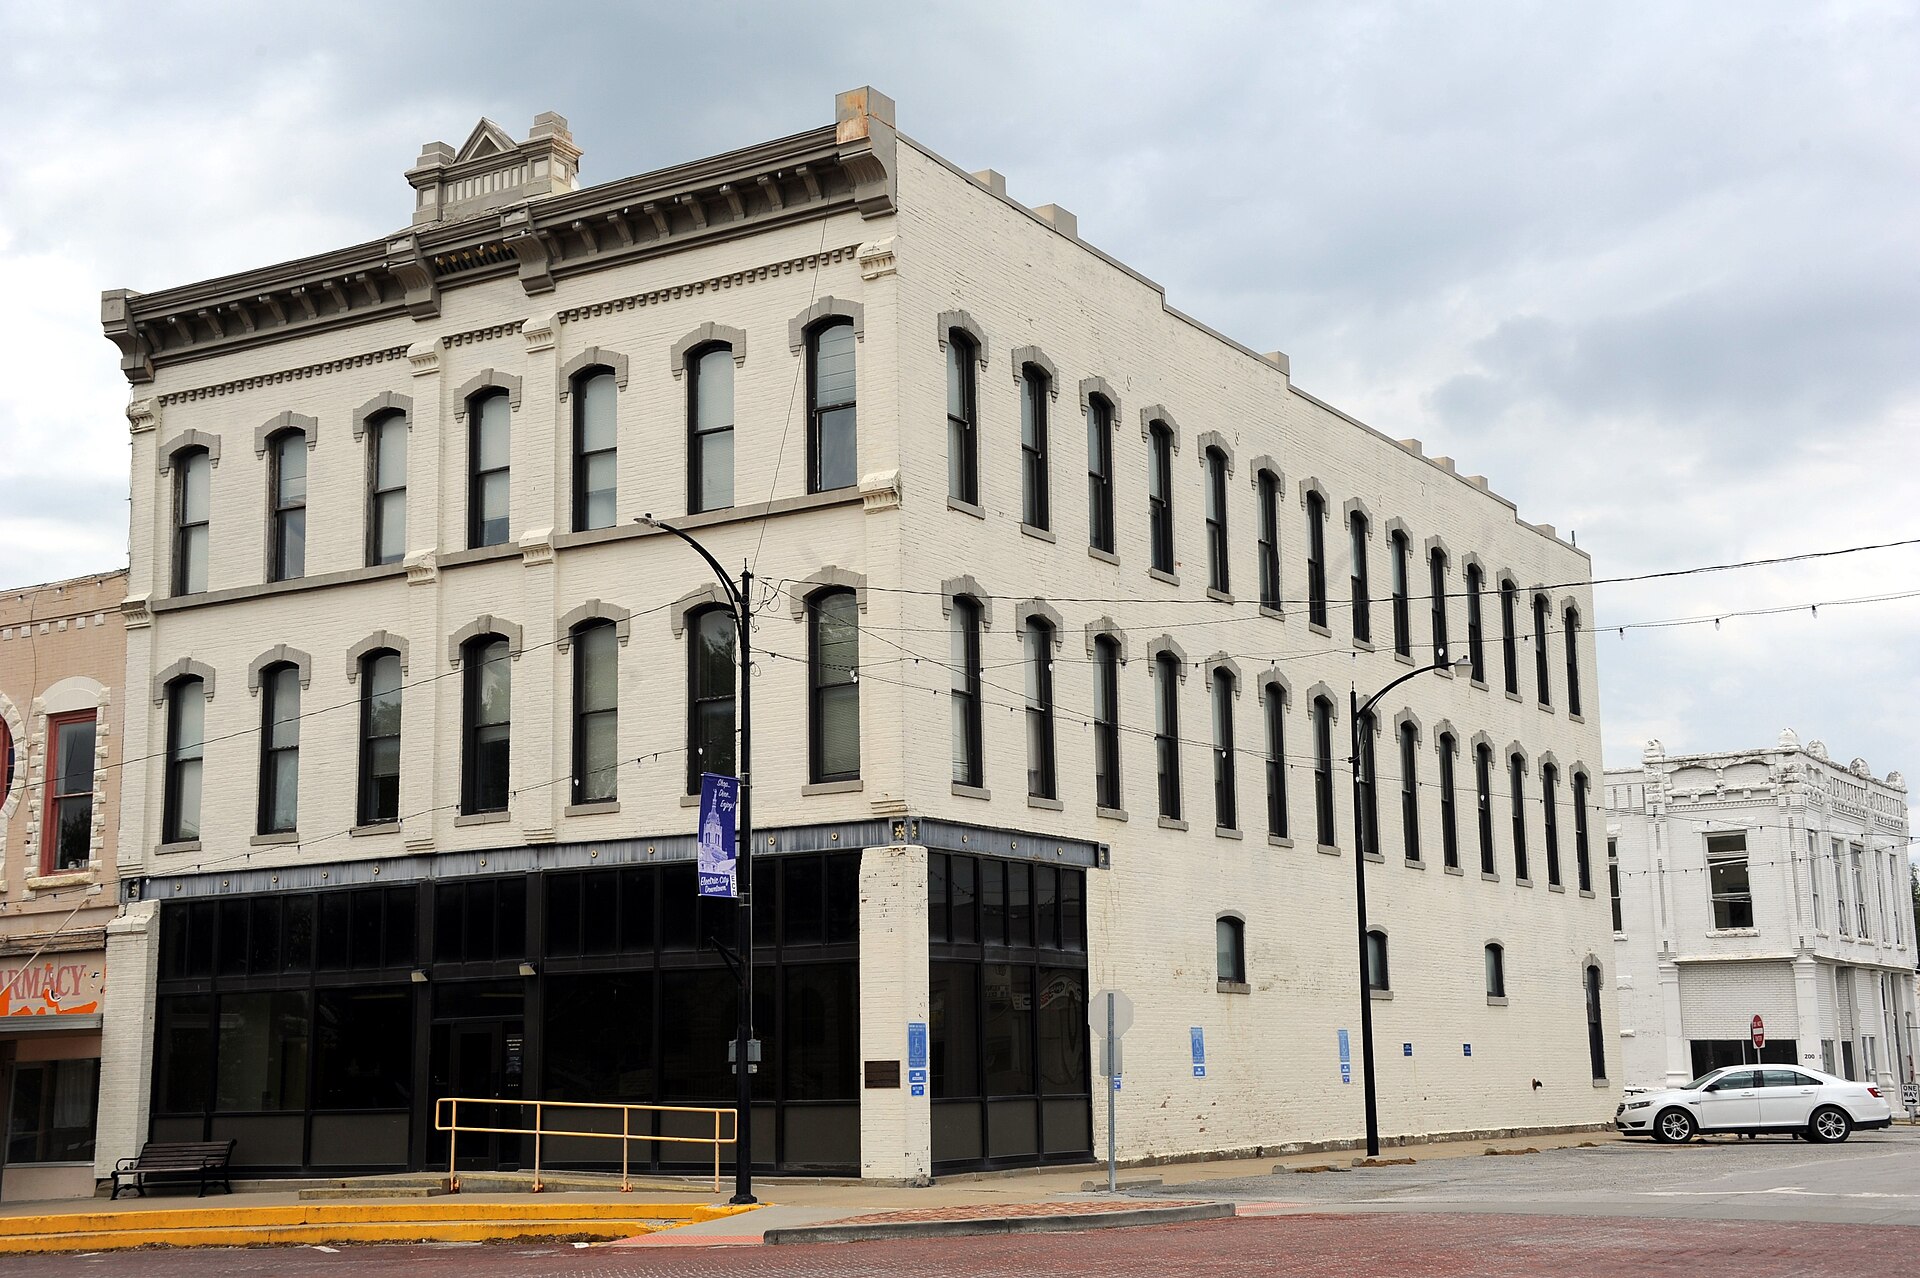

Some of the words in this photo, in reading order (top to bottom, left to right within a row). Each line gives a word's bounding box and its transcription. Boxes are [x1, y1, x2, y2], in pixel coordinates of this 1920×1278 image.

[720, 800, 735, 812] Enjoy!
[700, 876, 719, 886] Electric
[719, 876, 729, 886] City
[704, 885, 727, 893] Downtown
